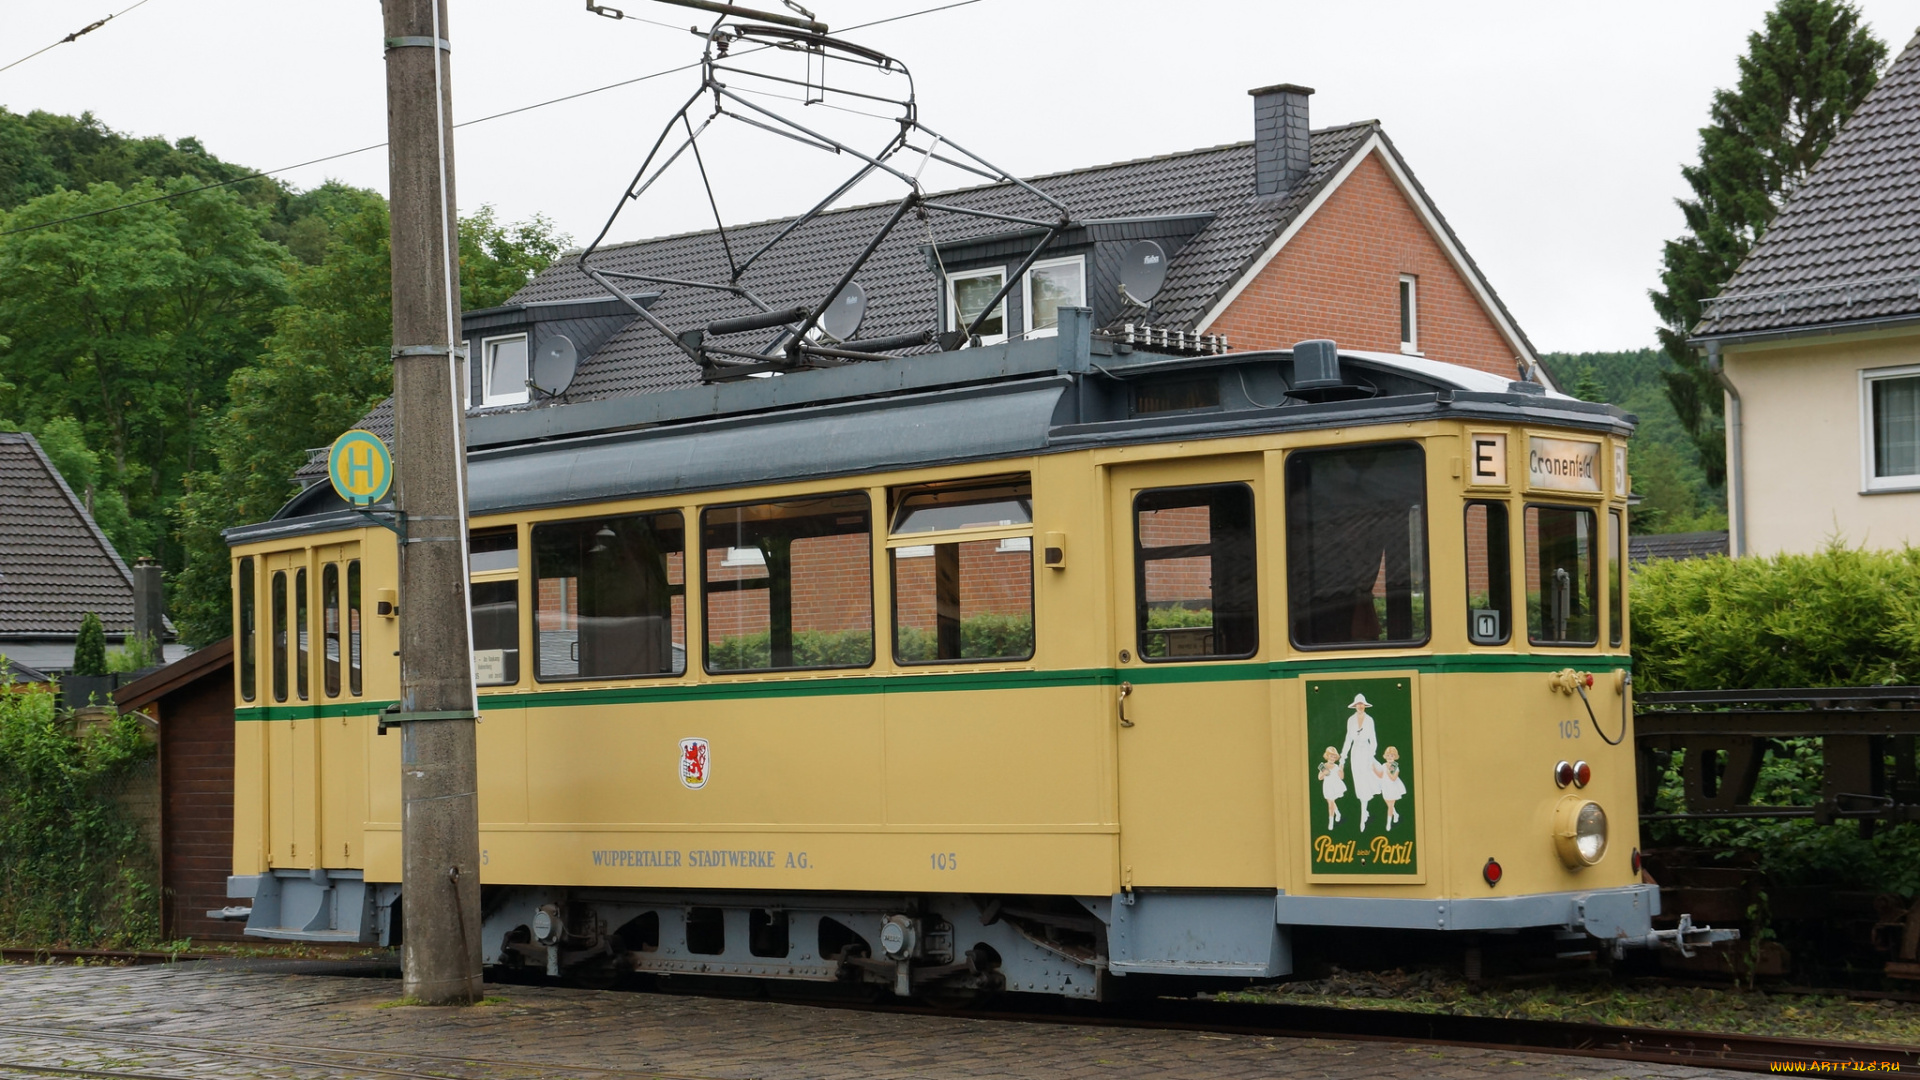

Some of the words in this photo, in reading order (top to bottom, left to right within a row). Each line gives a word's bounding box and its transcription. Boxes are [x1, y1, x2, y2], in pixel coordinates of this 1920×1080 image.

[348, 447, 374, 488] H
[1475, 440, 1496, 477] E
[1529, 449, 1593, 479] Cronenfeld
[1559, 720, 1581, 739] 105
[592, 850, 682, 867] WUPPERTALER
[688, 851, 775, 867] STADTWERKE
[785, 852, 813, 869] AG.
[930, 853, 957, 870] 105
[1314, 835, 1356, 863] Persil
[1370, 836, 1413, 864] Persil
